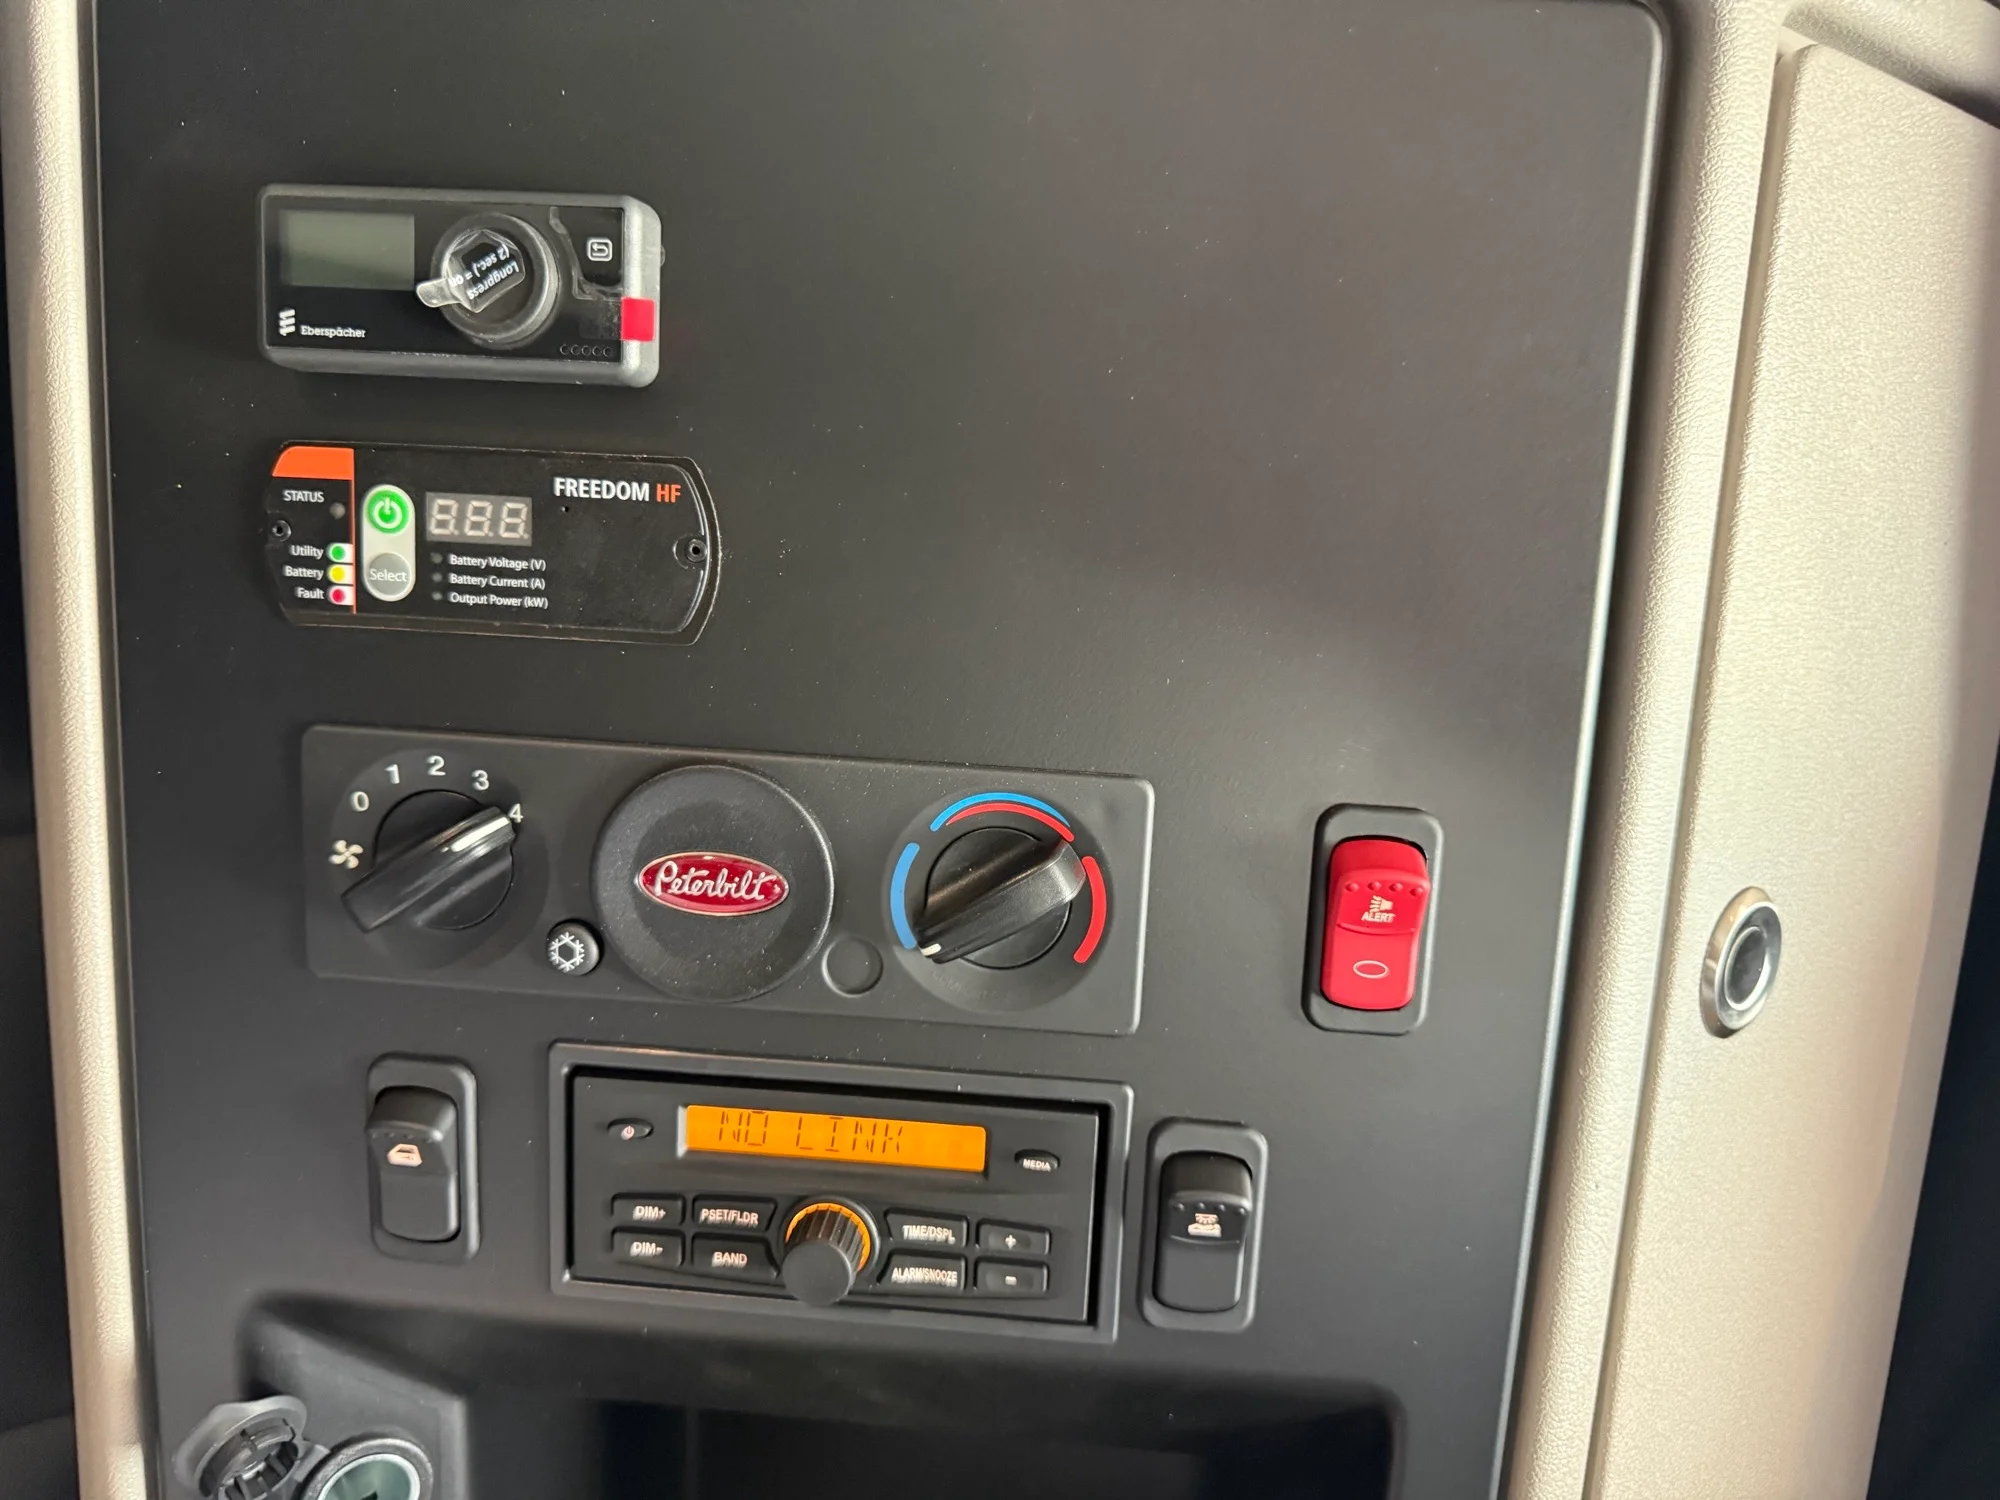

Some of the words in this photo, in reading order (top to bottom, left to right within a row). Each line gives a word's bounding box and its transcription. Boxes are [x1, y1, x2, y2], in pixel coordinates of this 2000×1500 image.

[466, 260, 519, 300] Longpress
[300, 324, 366, 339] Eberspächer
[283, 489, 325, 503] STATUS
[553, 476, 650, 502] FREEDOM
[655, 483, 682, 504] HF
[290, 544, 324, 560] Utility
[448, 553, 488, 570] Battery
[488, 556, 529, 572] Voltage
[530, 558, 547, 572] (V)
[284, 565, 324, 581] Battery
[369, 569, 408, 582] Select
[448, 572, 488, 589] Battery
[489, 575, 529, 589] Current
[530, 577, 546, 591] (A)
[295, 586, 325, 600] Fault
[448, 591, 488, 607] Output
[489, 594, 523, 608] Power
[523, 595, 549, 610] (kW)
[351, 790, 370, 812] 0
[385, 763, 401, 785] 1
[426, 755, 446, 776] 2
[471, 769, 490, 791] 3
[507, 803, 524, 823] 4
[654, 860, 778, 901] Peterbilt
[1361, 911, 1396, 923] ALERT
[718, 1110, 769, 1147] NO
[796, 1116, 903, 1154] LINK
[1022, 1158, 1052, 1172] MEDIA
[633, 1205, 667, 1221] DIM+
[700, 1208, 760, 1228] PSET/FLDR
[902, 1224, 957, 1245] TIME/DSPL
[711, 1251, 749, 1269] BAND
[891, 1266, 959, 1288] ALARM/SNOOZE
